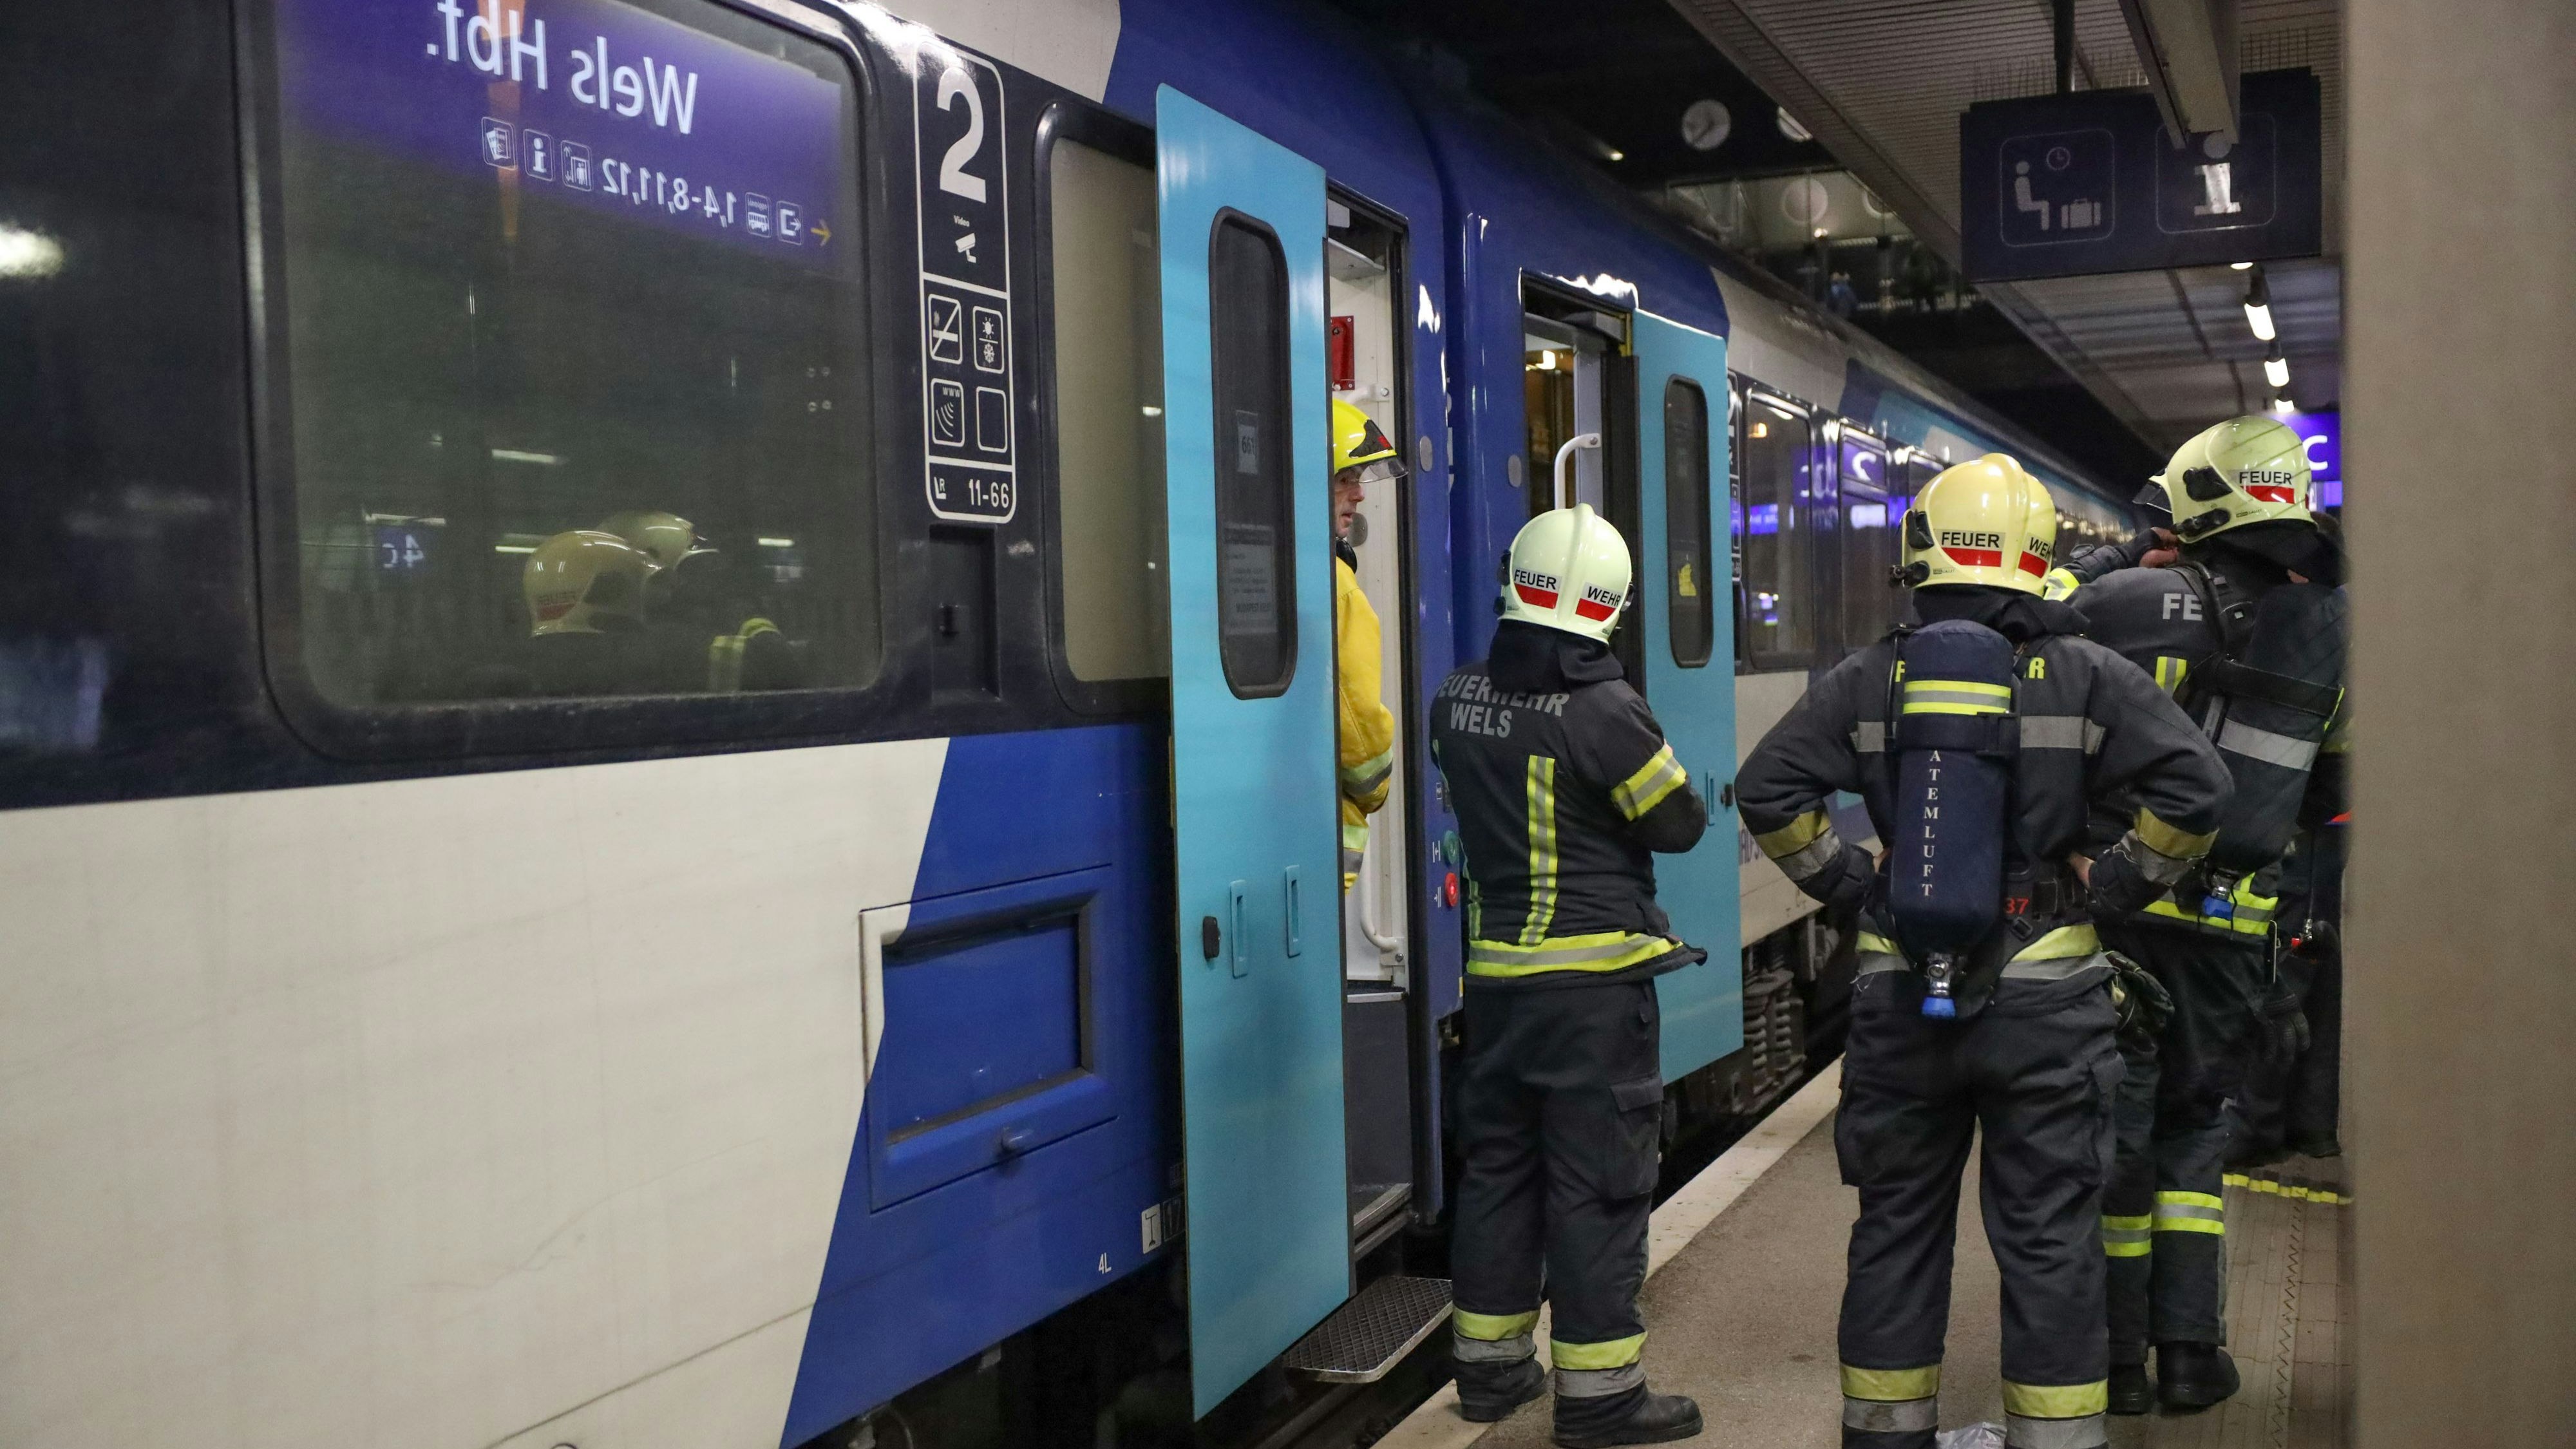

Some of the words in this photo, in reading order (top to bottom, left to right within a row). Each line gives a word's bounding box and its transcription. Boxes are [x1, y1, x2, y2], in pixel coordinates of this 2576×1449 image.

[936, 66, 987, 204] 2
[953, 214, 971, 228] Video
[2302, 435, 2328, 471] C
[968, 478, 1010, 509] 11-66
[2239, 471, 2293, 486] FEUER
[1940, 532, 2000, 549] FEUER
[2029, 537, 2052, 561] WEH
[1514, 569, 1557, 591] FEUER
[1587, 587, 1622, 607] WEHR
[2162, 592, 2203, 621] FE
[1450, 702, 1513, 738] WELS
[1922, 749, 1941, 897] ATEMLUFT
[2004, 898, 2029, 914] 37
[1098, 1252, 1112, 1274] 4L
